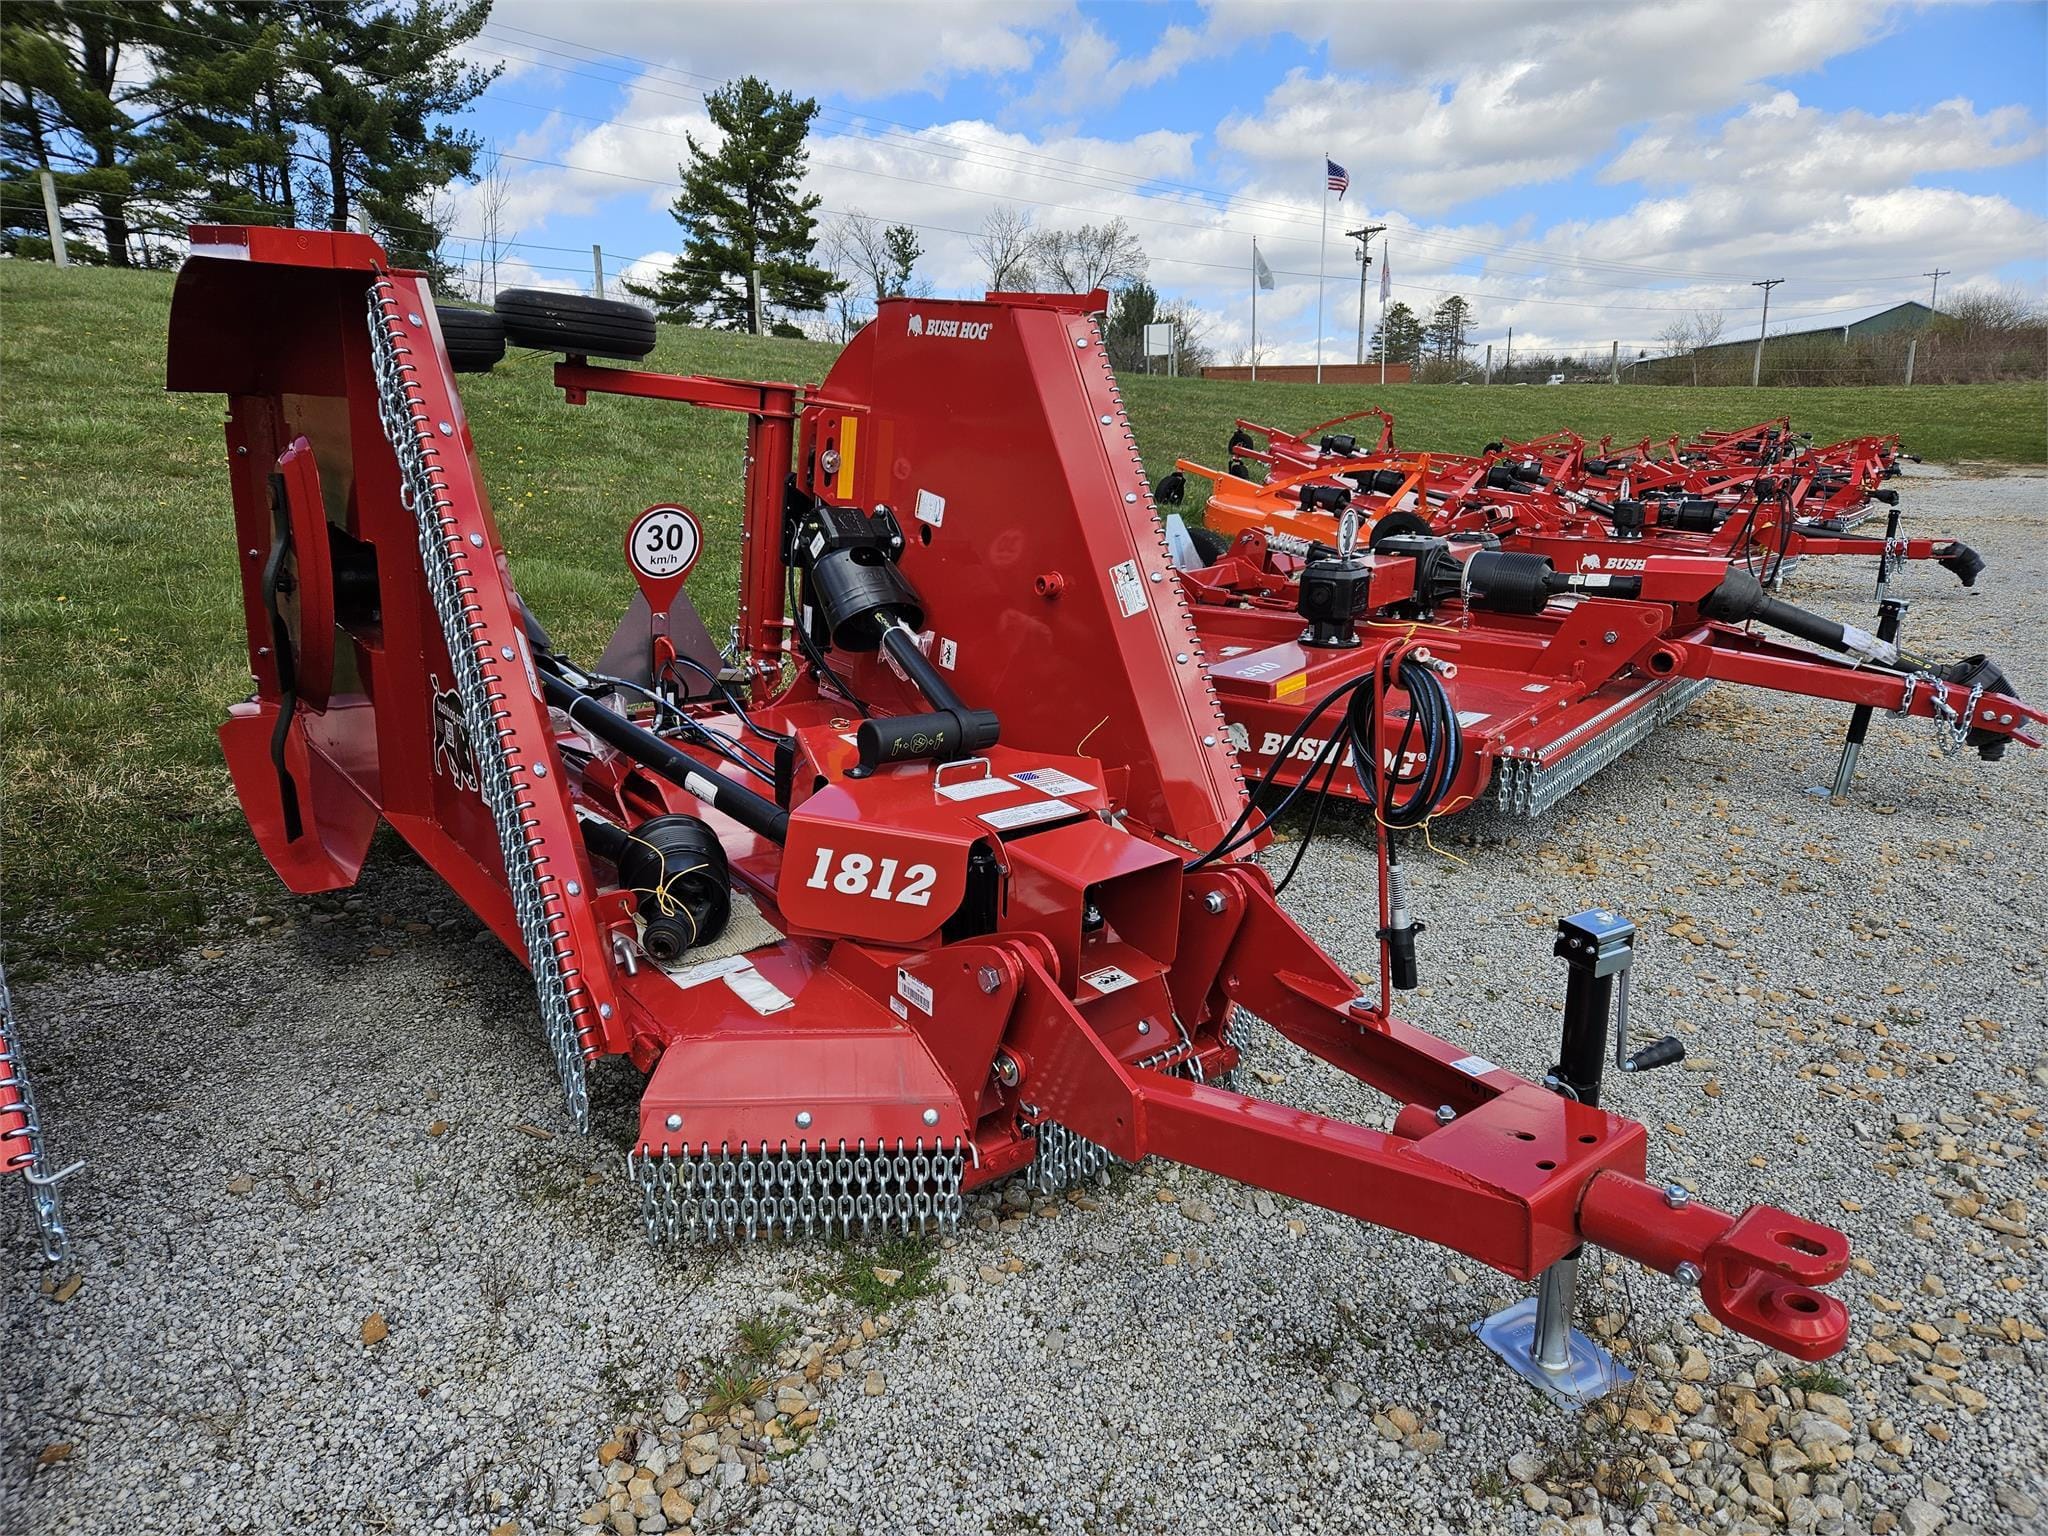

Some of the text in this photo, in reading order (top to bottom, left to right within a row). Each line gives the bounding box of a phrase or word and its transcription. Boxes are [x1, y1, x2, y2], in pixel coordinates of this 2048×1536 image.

[925, 319, 959, 337] BUSH
[646, 524, 683, 552] 30
[650, 554, 677, 565] km/h
[1604, 557, 1647, 571] BUSH
[806, 847, 937, 907] 1812
